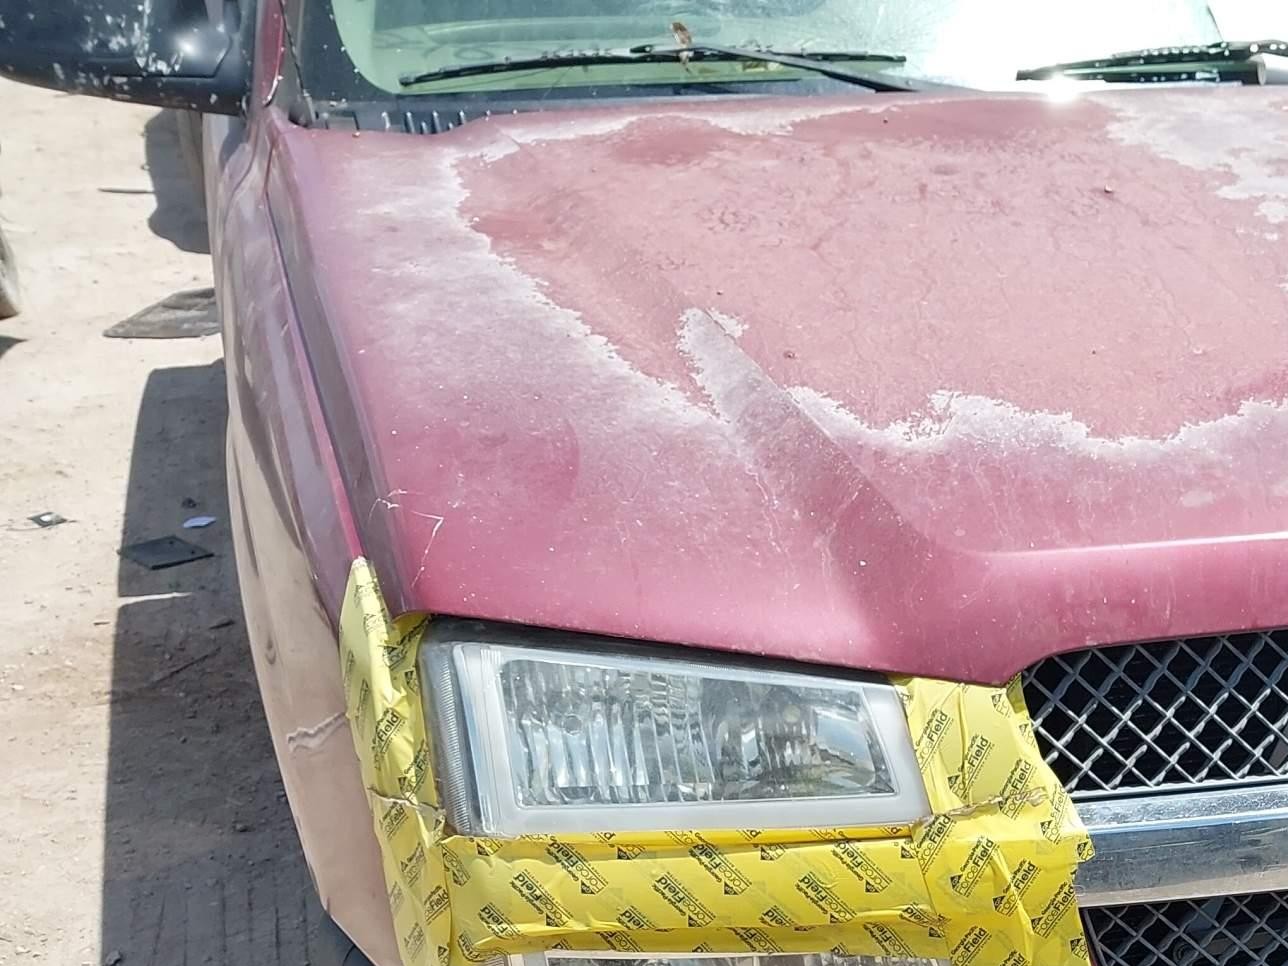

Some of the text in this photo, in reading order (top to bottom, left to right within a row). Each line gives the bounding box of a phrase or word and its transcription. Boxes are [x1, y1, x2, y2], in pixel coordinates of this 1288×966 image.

[548, 840, 605, 894] ForceField
[693, 842, 748, 894] ForceField
[834, 840, 888, 892] ForceField
[954, 839, 994, 895] ForceField
[513, 872, 569, 927] ForceField
[656, 875, 711, 927] ForceField
[799, 874, 852, 924] ForceField
[1034, 884, 1075, 937] ForceField
